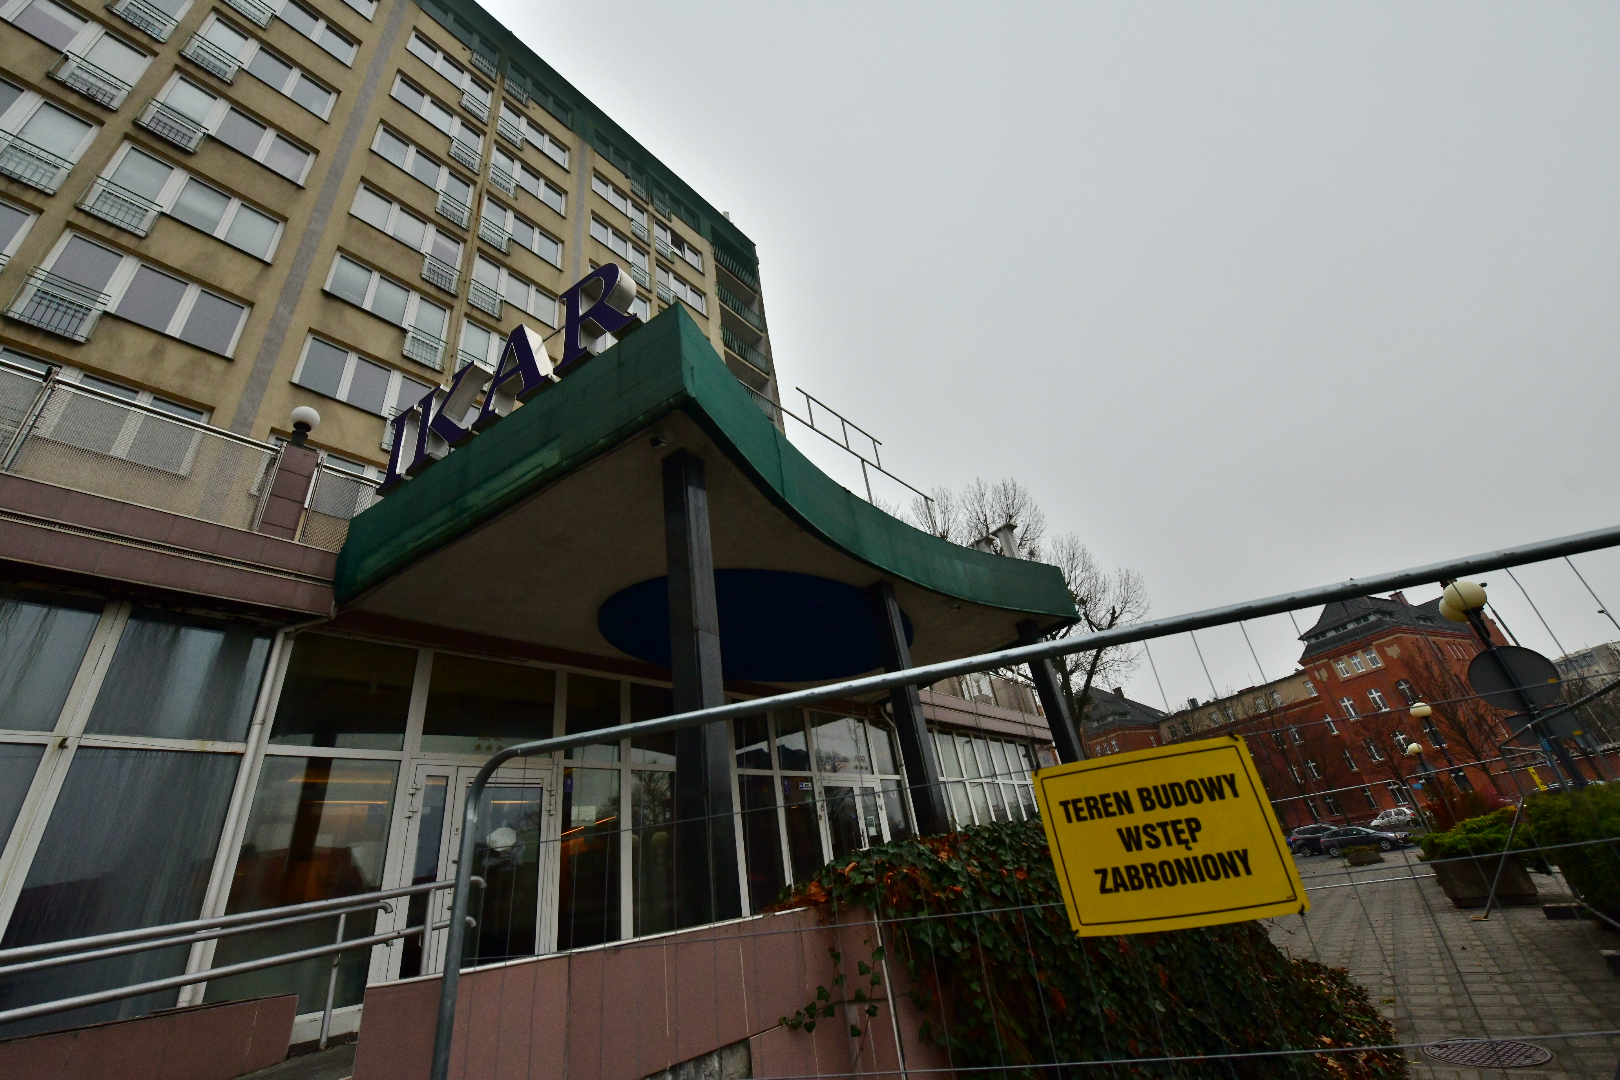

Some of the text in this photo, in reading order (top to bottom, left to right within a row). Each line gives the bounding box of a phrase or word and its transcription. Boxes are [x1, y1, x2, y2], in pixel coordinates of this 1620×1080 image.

[376, 263, 639, 495] IKAR
[1059, 773, 1239, 823] TEREN BUDOWY
[1116, 817, 1202, 851] WSTĘP
[1094, 848, 1252, 894] ZABRONIONY
